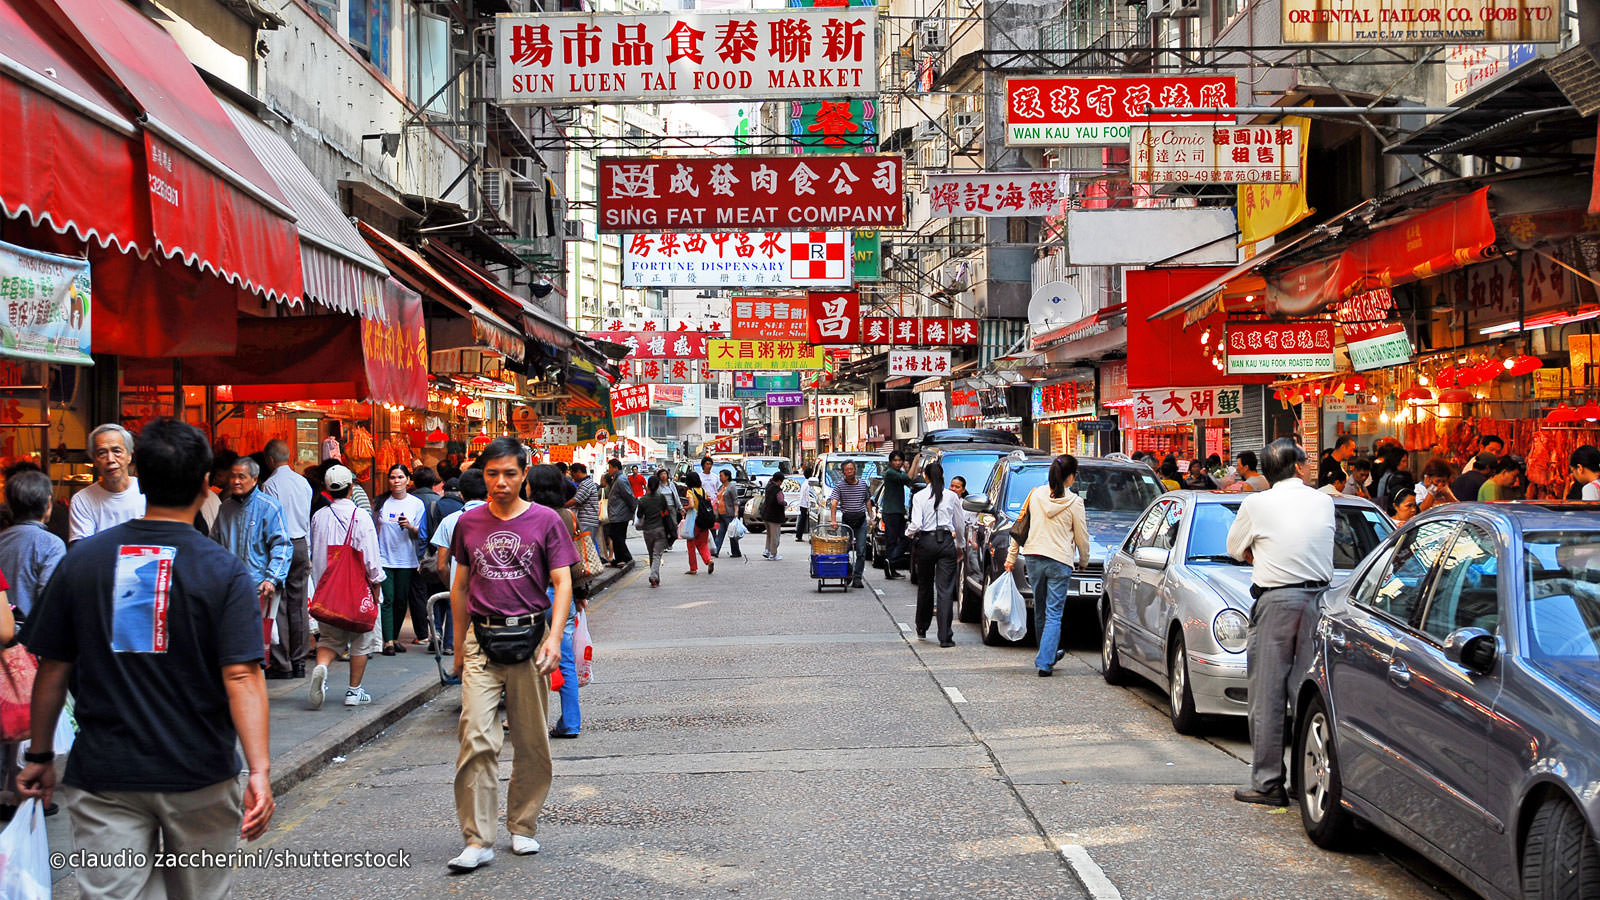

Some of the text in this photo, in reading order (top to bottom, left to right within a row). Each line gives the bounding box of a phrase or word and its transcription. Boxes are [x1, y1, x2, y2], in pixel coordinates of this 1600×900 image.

[1288, 6, 1553, 24] ORIENTAL TAILOR CO. (BOB YU)
[1356, 30, 1377, 39] FLAT
[1389, 30, 1404, 39] 1/F
[1406, 30, 1419, 39] FU
[1420, 30, 1445, 39] YUEN
[1446, 29, 1486, 38] MANSION
[512, 68, 864, 93] SUN LUEN TAI FOOD MARKET
[1013, 126, 1041, 139] WAN
[1044, 126, 1070, 138] KAU
[1075, 126, 1100, 138] YAU
[1137, 128, 1205, 149] Lee Comic
[1138, 149, 1205, 164] 利達公司
[1232, 146, 1274, 164] 租售
[669, 160, 897, 198] 成發肉食公司
[606, 205, 897, 226] SING FAT MEAT COMPANY
[632, 261, 785, 271] FORTUNE DISPENSARY
[736, 302, 807, 319] 百事吉餅
[816, 297, 851, 340] 昌
[718, 341, 815, 359] 大昌粥粉麵
[1231, 358, 1330, 368] WAN KAU YAU FOOK ROASTED FOOD
